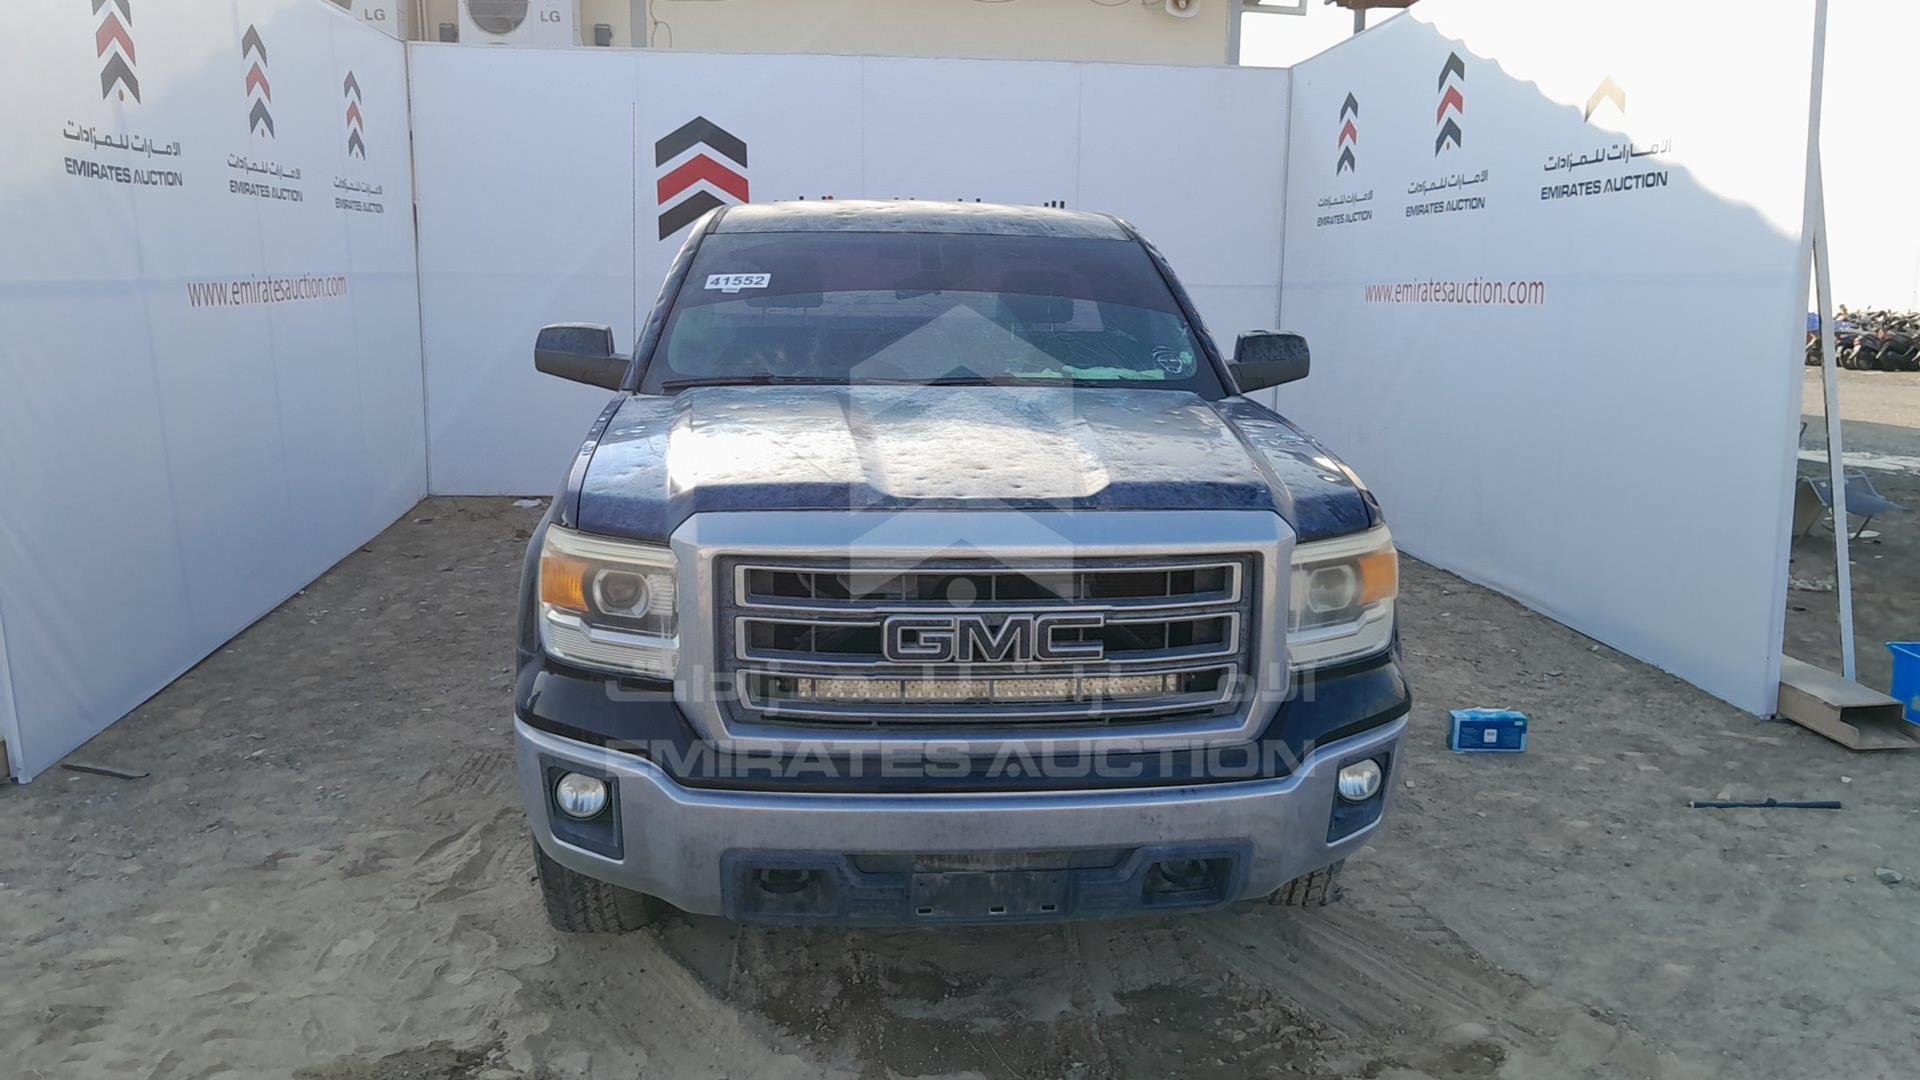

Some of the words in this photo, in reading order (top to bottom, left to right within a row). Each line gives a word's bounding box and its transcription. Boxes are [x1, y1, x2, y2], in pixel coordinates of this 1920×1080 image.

[364, 8, 386, 21] LG
[540, 10, 560, 23] LG
[64, 157, 131, 184] EMIRATES
[133, 169, 183, 187] AUCTION
[229, 179, 270, 198] EMIRATES
[1541, 180, 1601, 200] EMIRATES
[1603, 171, 1669, 193] AUCTION
[1405, 201, 1445, 217] EMIRATES
[1445, 196, 1486, 212] AUCTION
[187, 272, 347, 307] www.emiratesauction.com
[709, 275, 765, 286] 41552
[1364, 276, 1546, 305] www.emiratesauction.com
[883, 614, 1104, 663] GMC
